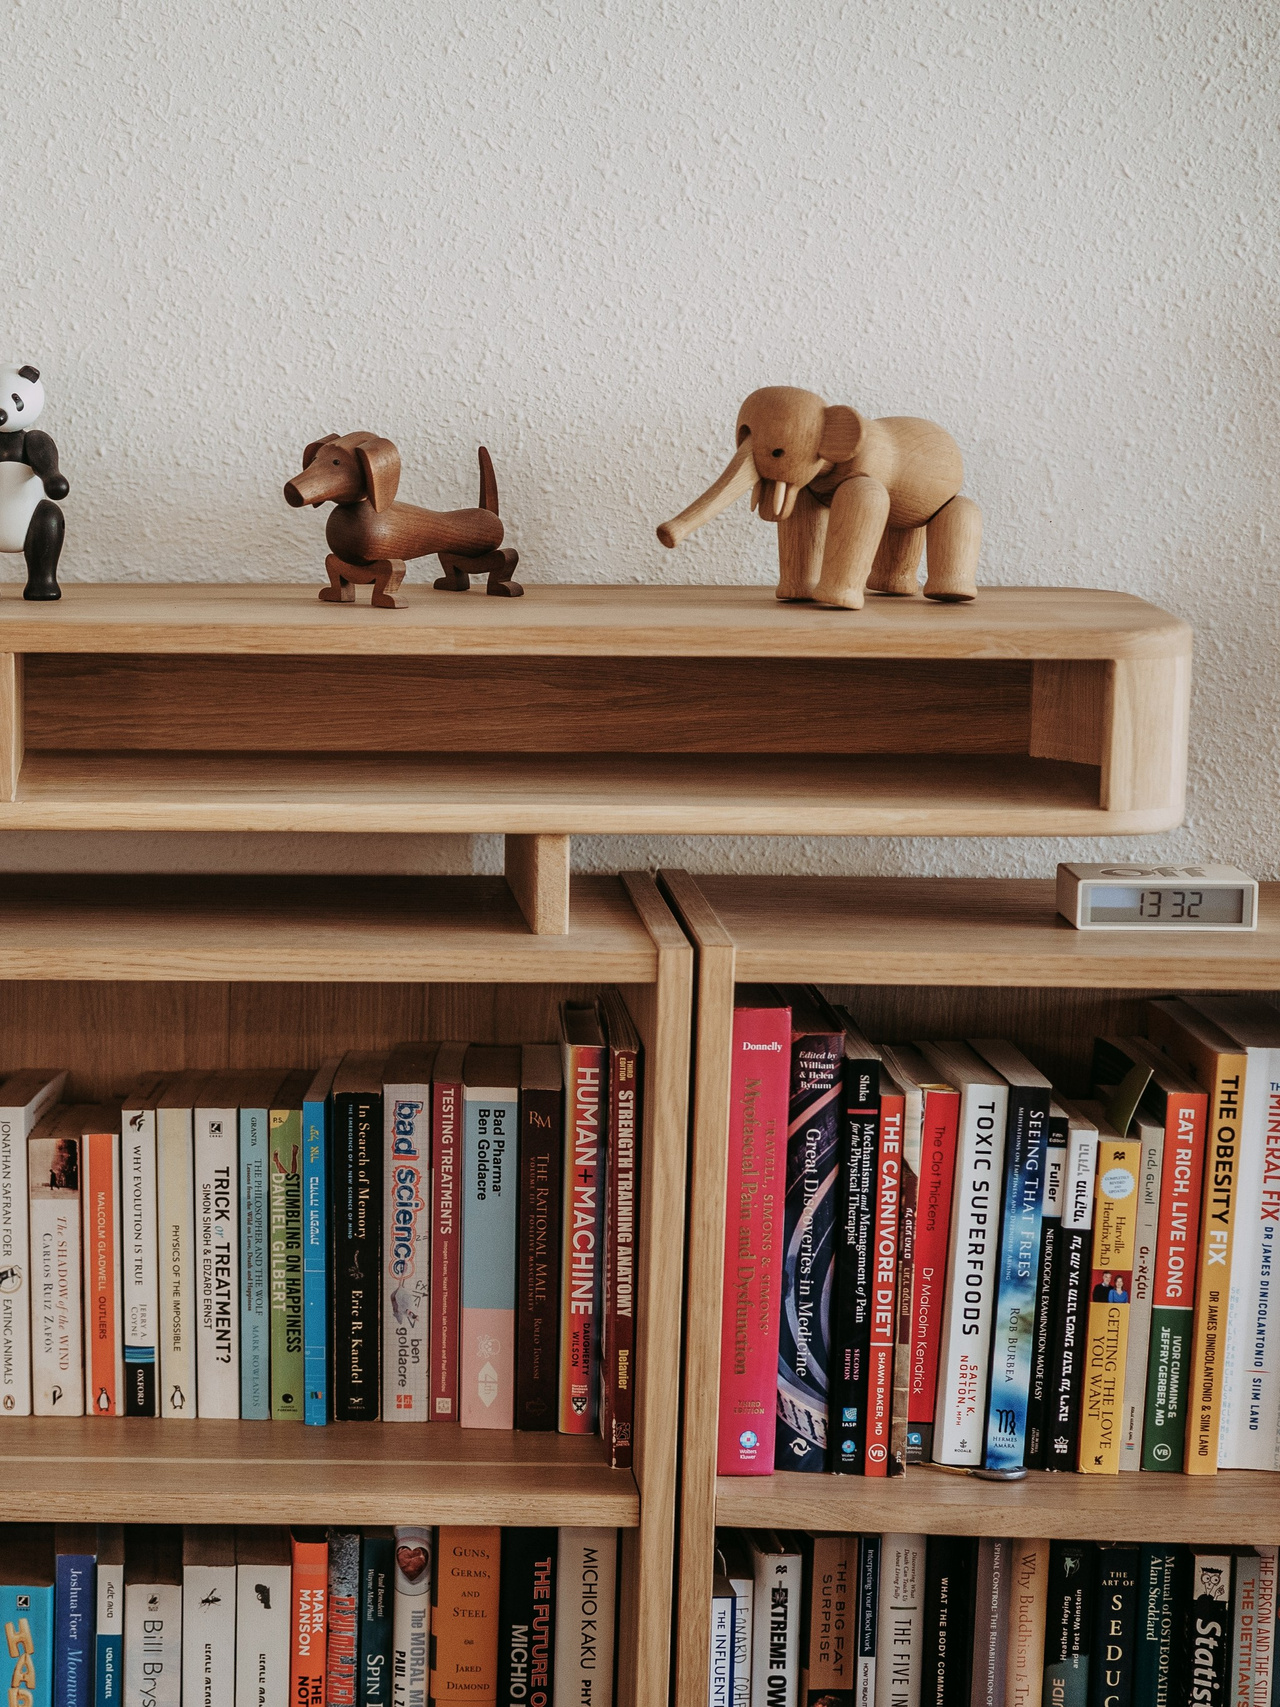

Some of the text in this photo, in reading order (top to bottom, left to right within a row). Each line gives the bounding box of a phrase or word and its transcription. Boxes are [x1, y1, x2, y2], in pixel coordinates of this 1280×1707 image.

[1100, 866, 1207, 878] Off
[743, 1042, 782, 1052] Donnelly
[440, 1088, 454, 1234] TESTING TREATMENTS
[492, 1109, 505, 1131] Bad
[355, 1106, 369, 1239] In Search of Memory
[617, 1091, 633, 1317] STRENGTH TRAINING ANATOMY
[1017, 1111, 1044, 1277] SEEING THAT FREES
[1049, 1163, 1061, 1202] Fuller
[1166, 1109, 1195, 1297] EAT RICH, LIVE LONG
[1208, 1075, 1239, 1265] THE OBESITY FIX
[795, 1128, 821, 1376] Great Discoveries in Medicine
[876, 1113, 900, 1336] THE CARNIVORE DIET
[963, 1102, 995, 1335] TOXIC SUPERFOODS
[215, 1166, 231, 1363] TRICK or TREATMENT?
[285, 1173, 301, 1352] STUMBLING ON HAPPINESS
[3, 1299, 13, 1384] EATING ANIMALS
[619, 1350, 629, 1389] Delavier
[913, 1268, 933, 1394] Dr Malcolm Kendrick
[453, 1547, 489, 1559] GUNS,
[144, 1620, 163, 1652] Bill
[299, 1590, 311, 1655] MANSON
[312, 1590, 324, 1633] MARK
[453, 1607, 487, 1618] STEEL
[580, 1548, 598, 1669] MICHIO KAKU
[1146, 1556, 1162, 1640] Alan Stoddard
[447, 1682, 490, 1690] DIAMOND
[456, 1664, 481, 1673] JARED
